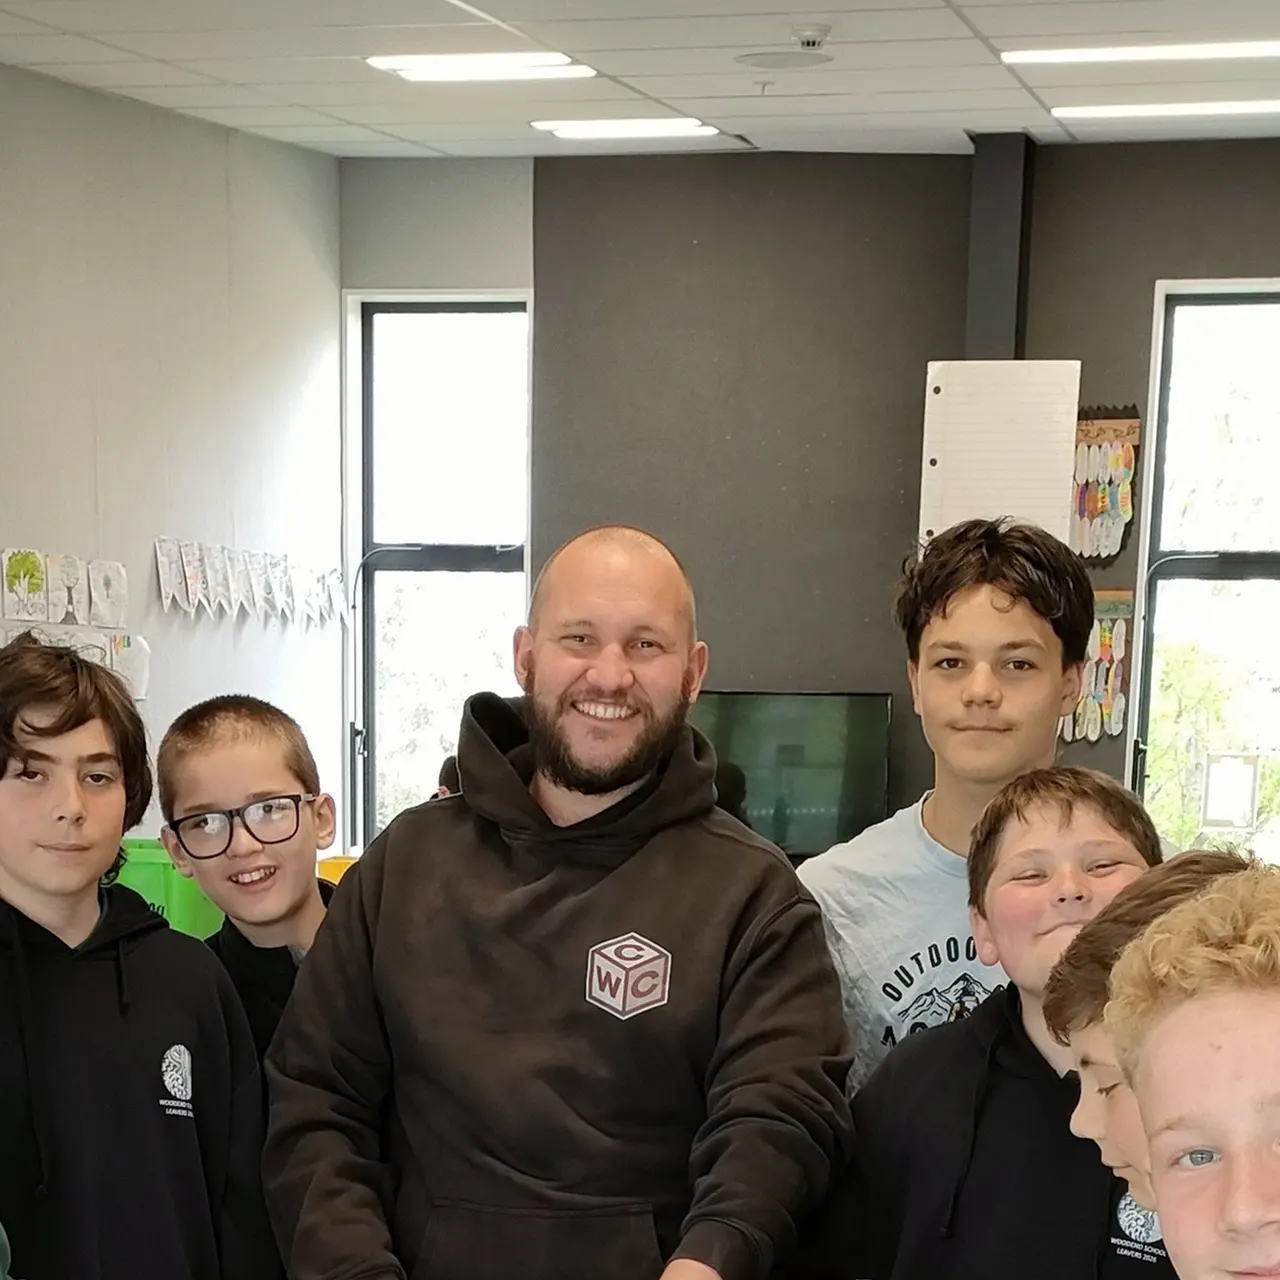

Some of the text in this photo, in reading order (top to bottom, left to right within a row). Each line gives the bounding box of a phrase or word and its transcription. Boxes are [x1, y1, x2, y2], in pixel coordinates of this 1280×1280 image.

[614, 944, 646, 962] C
[596, 965, 660, 999] W C
[882, 936, 977, 1002] OUTDOO
[1116, 1247, 1142, 1260] LEAVERS
